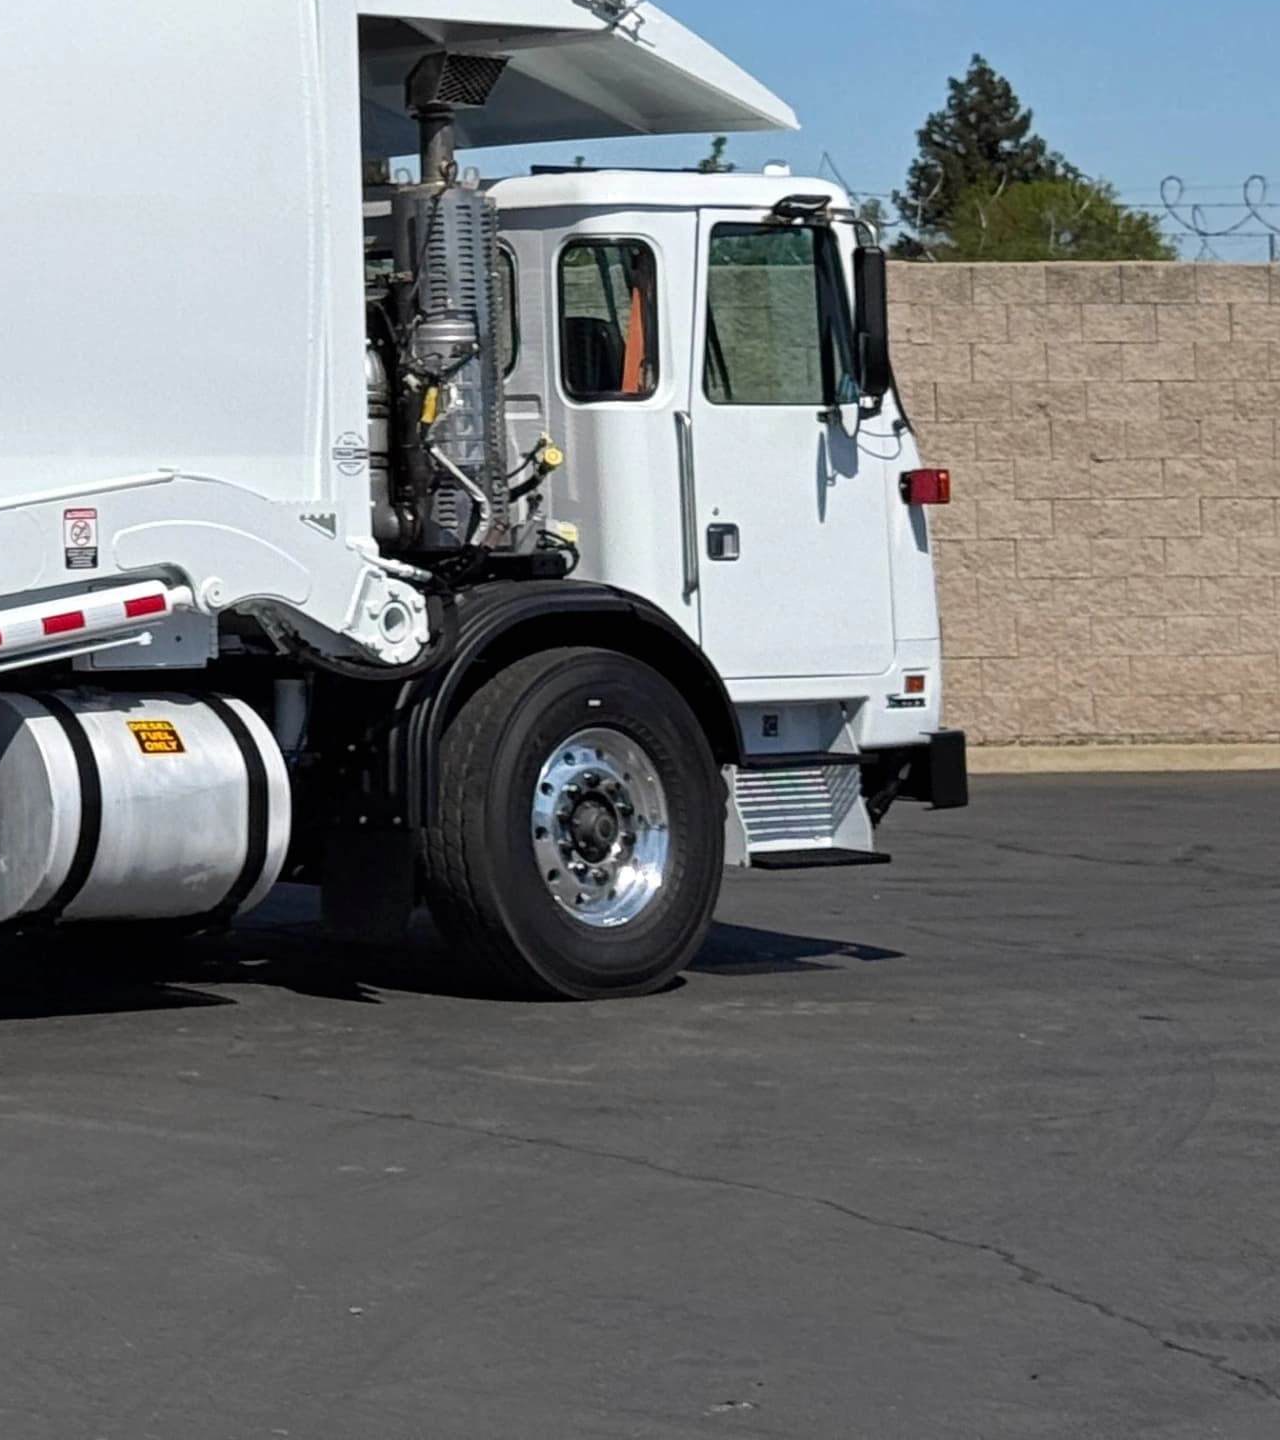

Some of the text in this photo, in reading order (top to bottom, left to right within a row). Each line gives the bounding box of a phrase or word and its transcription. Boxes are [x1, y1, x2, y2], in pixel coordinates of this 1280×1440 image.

[129, 722, 173, 730] DIESEL
[140, 732, 174, 740] FUEL
[144, 741, 177, 751] ONLY
